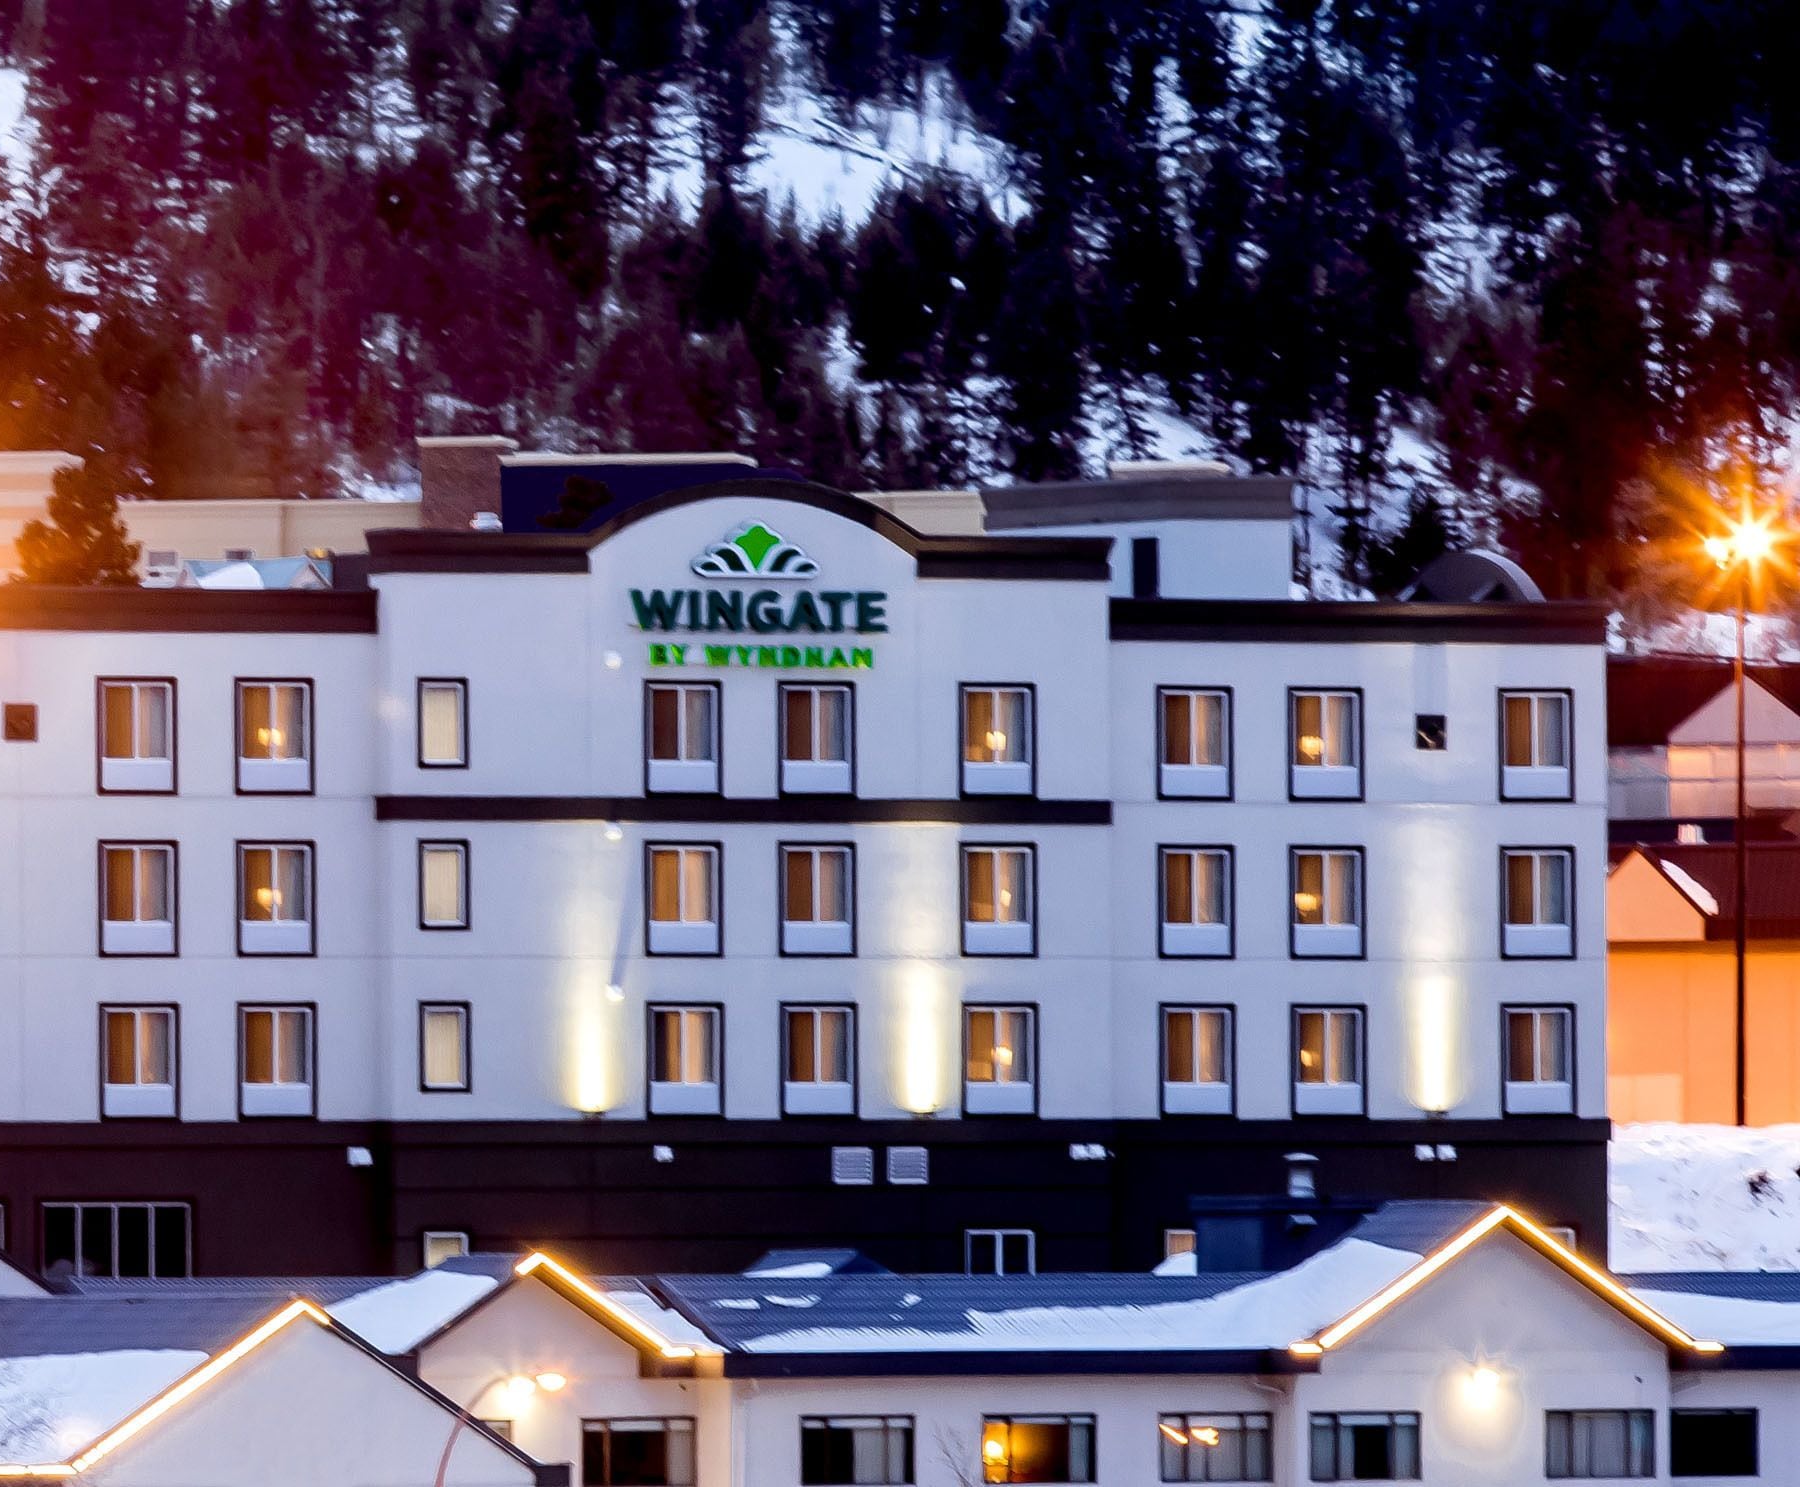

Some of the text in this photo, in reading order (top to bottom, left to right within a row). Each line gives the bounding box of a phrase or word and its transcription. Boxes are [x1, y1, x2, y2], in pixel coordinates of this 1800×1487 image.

[629, 589, 887, 632] WINGATE
[649, 643, 873, 669] BY WYNDHAM
